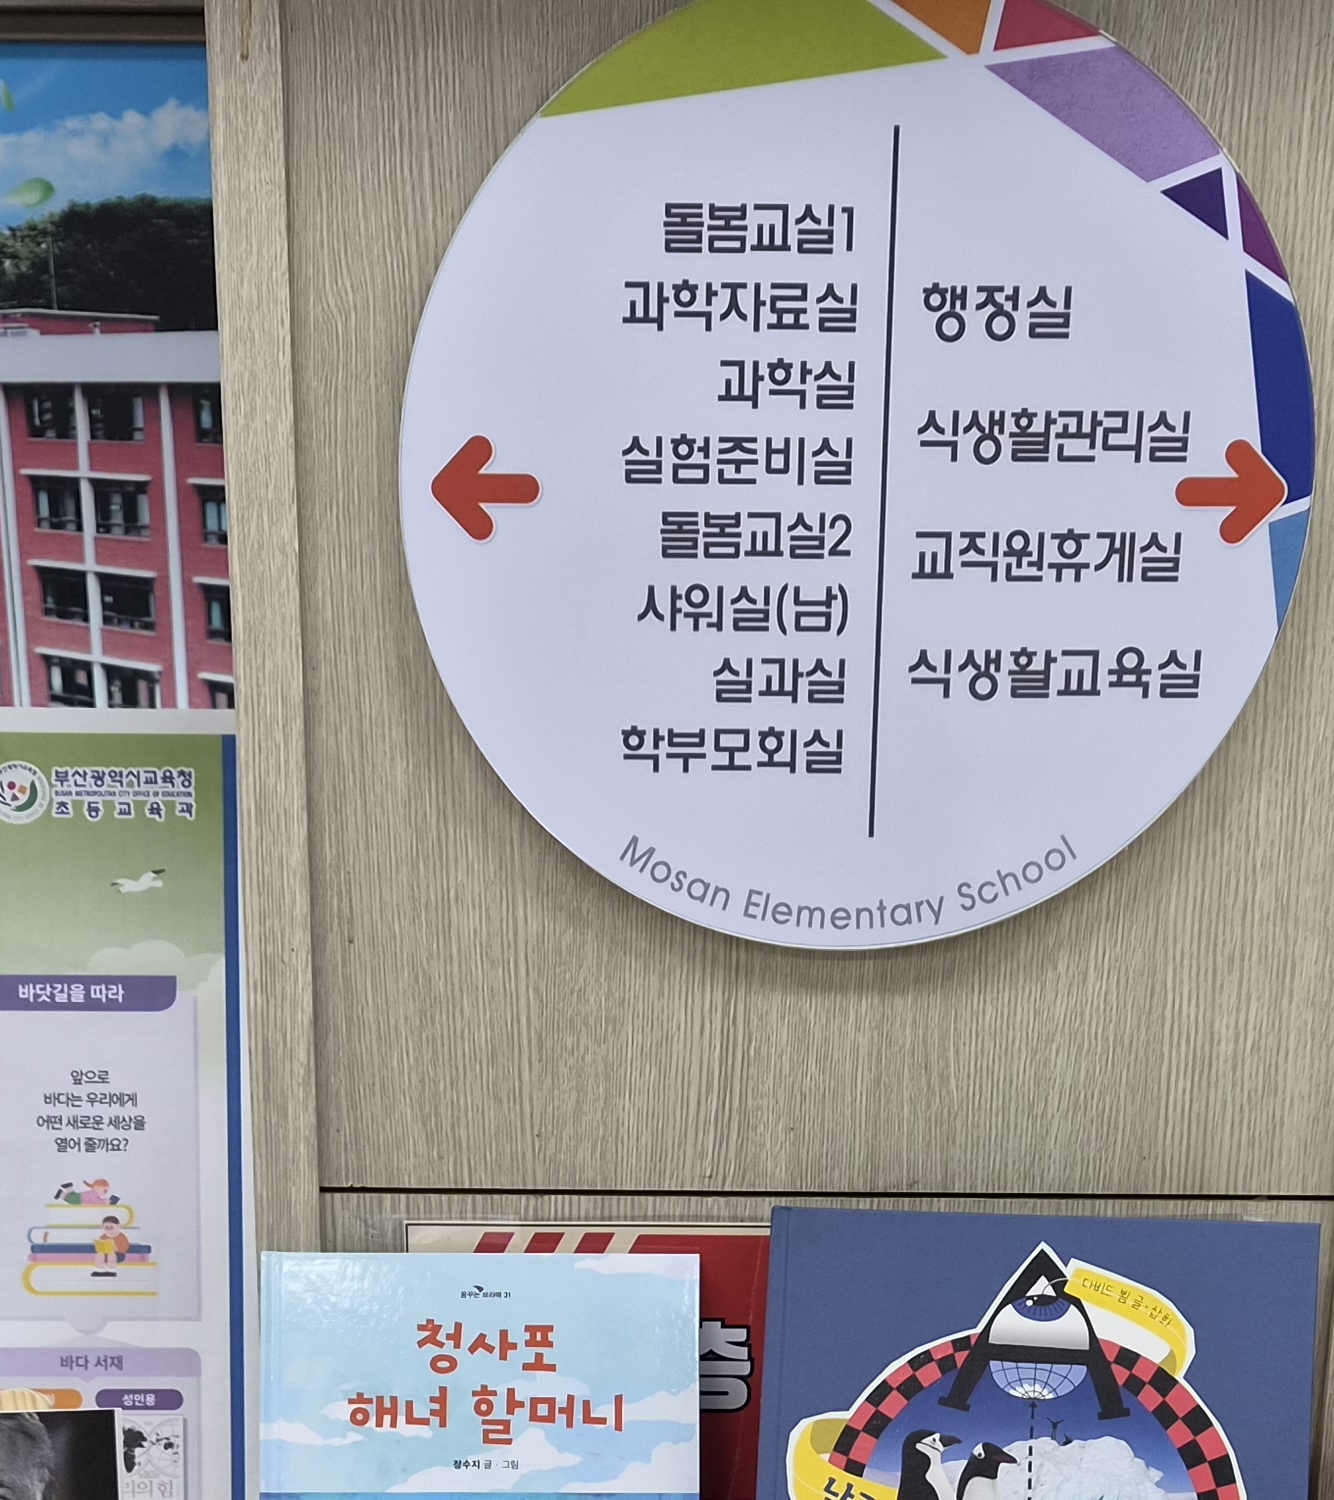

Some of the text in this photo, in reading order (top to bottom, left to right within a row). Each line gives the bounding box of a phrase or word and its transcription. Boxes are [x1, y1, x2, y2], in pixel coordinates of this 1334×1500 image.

[662, 201, 856, 255] 돌봄교실1
[622, 280, 859, 334] 과학자료실
[922, 283, 1072, 342] 행정실
[717, 358, 856, 409] 과학실
[621, 436, 855, 486] 실험준비실
[916, 408, 1192, 465] 식생활관리실
[660, 512, 852, 560] 돌봄교실2
[911, 529, 1183, 584] 교직원휴게실
[636, 584, 849, 634] 샤워실(남)
[712, 658, 847, 705] 실과실
[908, 647, 1203, 701] 식생활교육실
[621, 726, 844, 775] 학부모회실
[55, 769, 193, 788] 부산광역시교육청
[619, 834, 1079, 931] Mosan Elementary School
[18, 984, 124, 1002] 바닷길을 따라
[44, 1092, 137, 1107] 바다는 우리에게
[71, 1070, 110, 1085] 앞으로
[37, 1115, 146, 1130] 어떤 새로운 세상을
[55, 1137, 129, 1152] 열어 줄까요?
[416, 1317, 557, 1375] 청사포
[347, 1383, 624, 1446] 해녀 할머니
